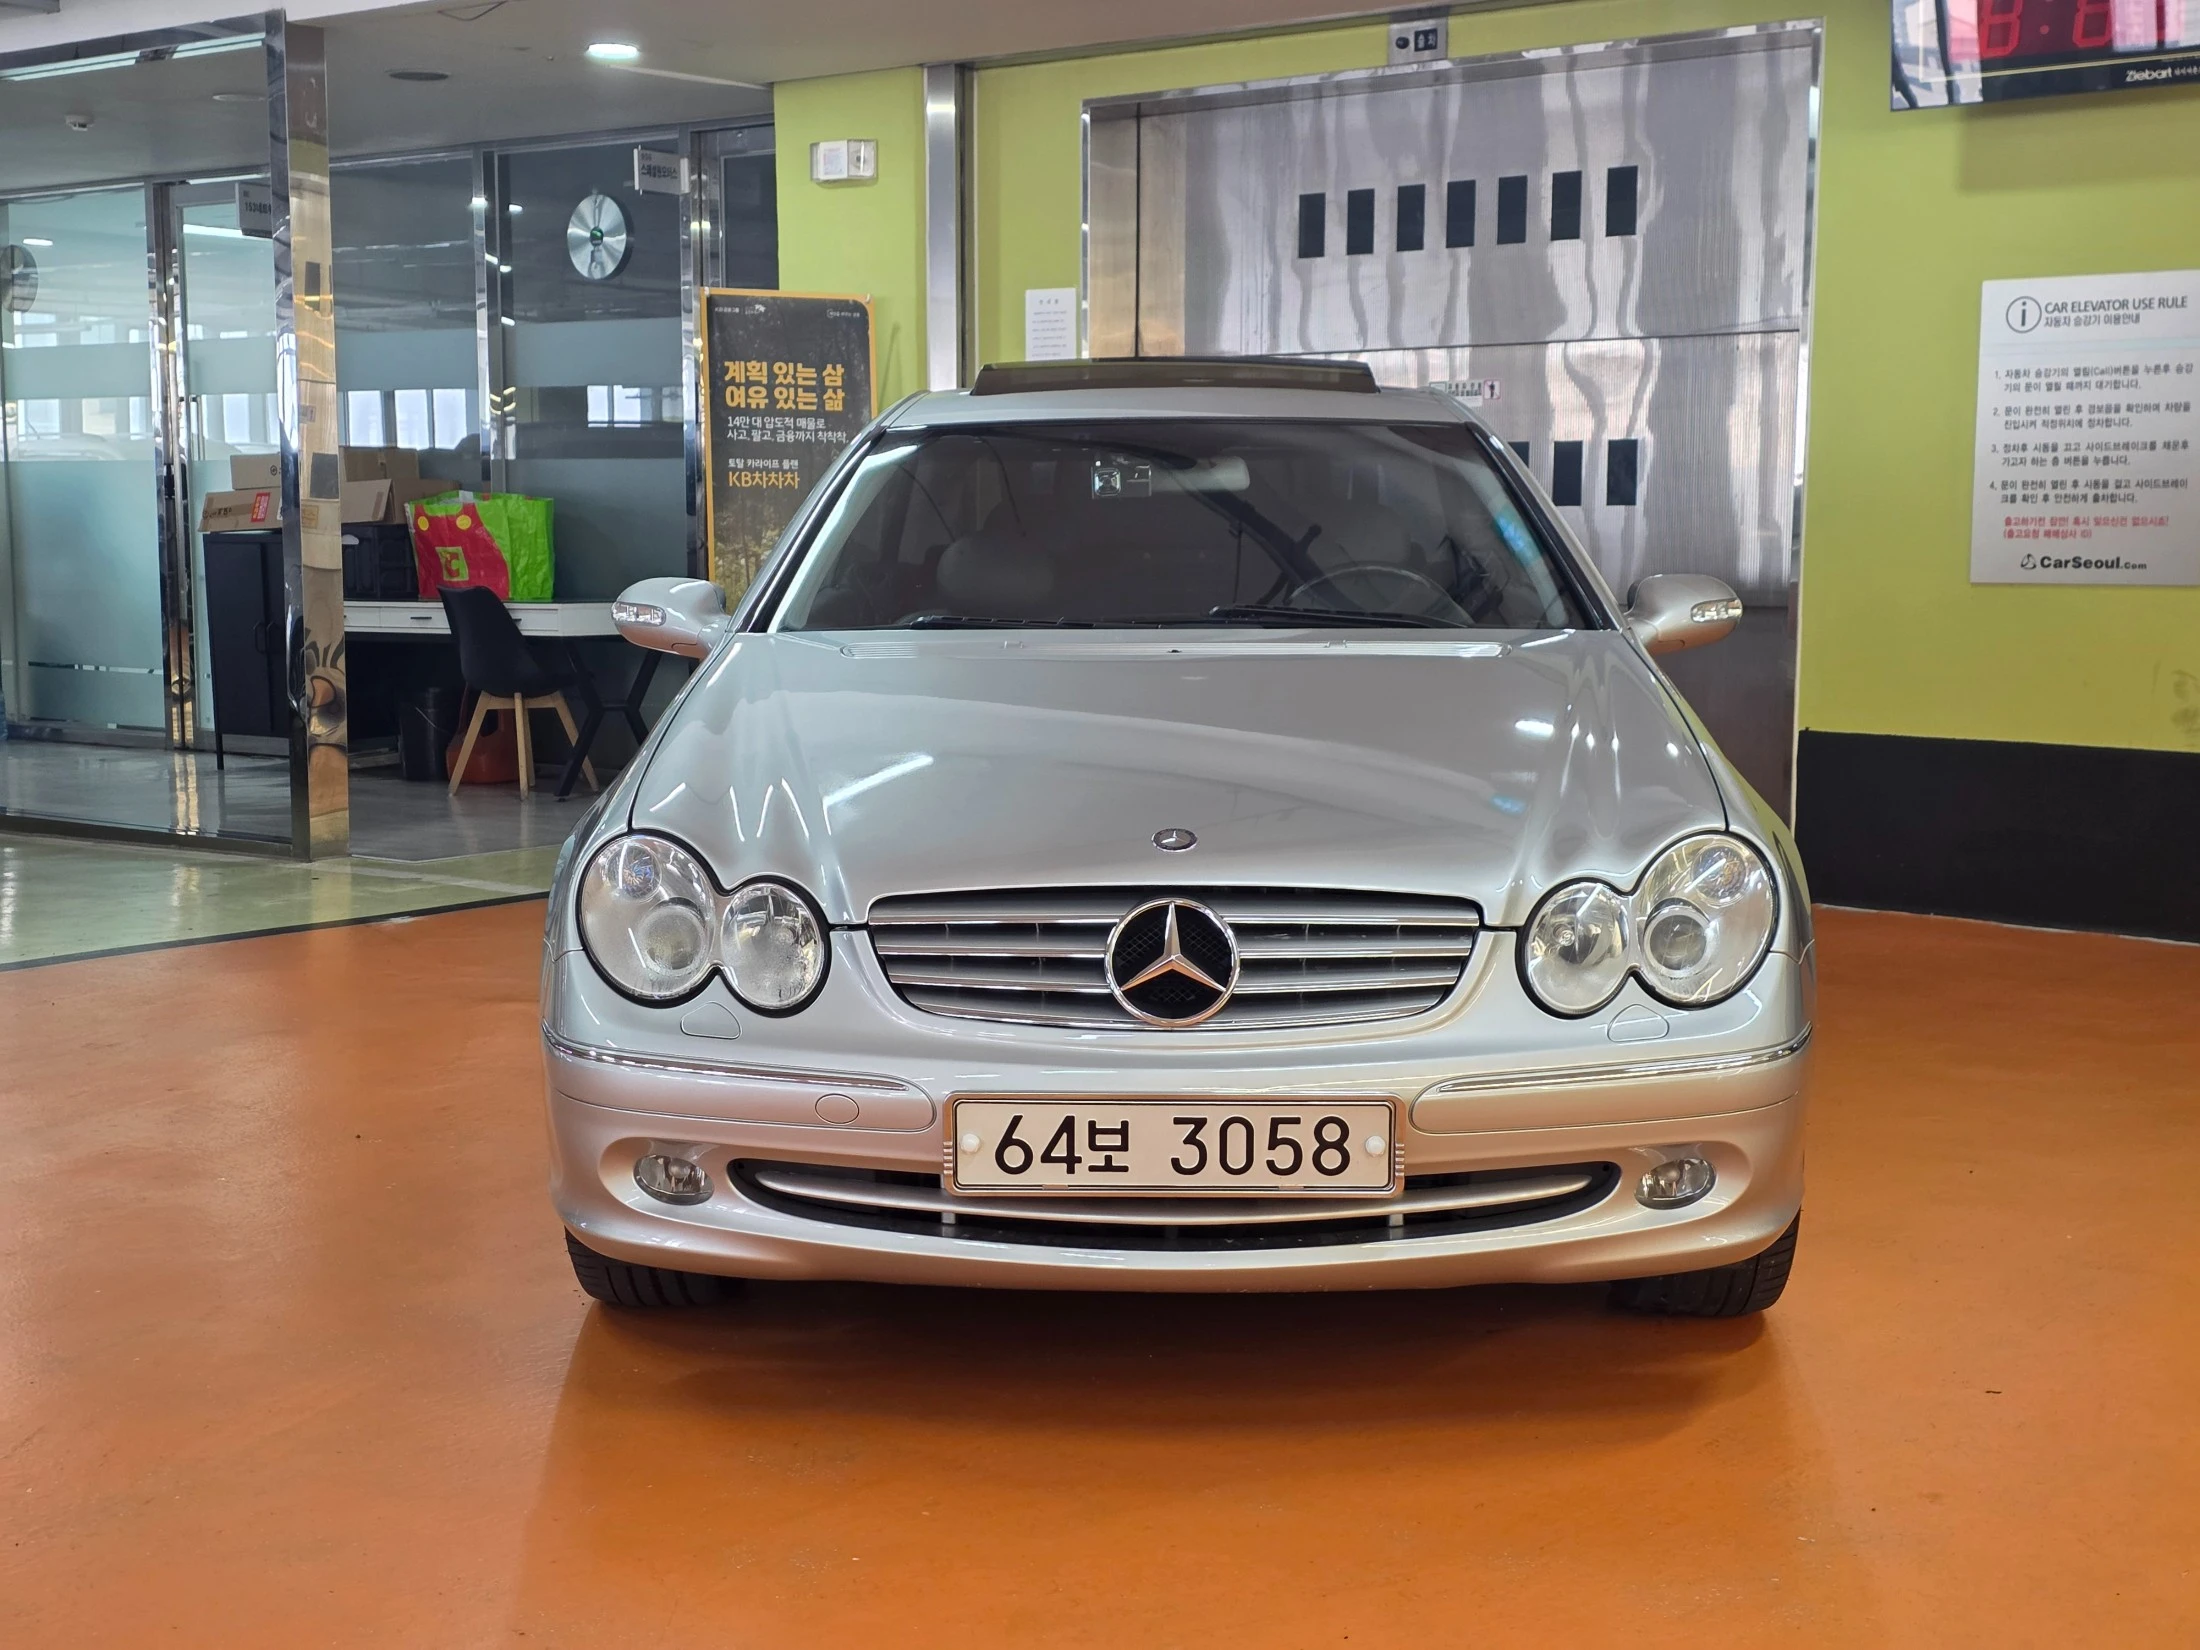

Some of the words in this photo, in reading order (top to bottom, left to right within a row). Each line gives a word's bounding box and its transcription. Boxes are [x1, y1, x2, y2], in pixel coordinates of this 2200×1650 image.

[2044, 302, 2068, 314] CAR
[2071, 299, 2129, 313] ELEVATOR
[2132, 297, 2155, 310] USE
[2158, 295, 2188, 309] RULE
[724, 360, 768, 385] 계획
[772, 361, 817, 386] 있는
[822, 363, 845, 387] 삼
[725, 385, 769, 409] 여유
[773, 386, 818, 410] 있는
[823, 388, 846, 412] 삶
[728, 416, 750, 429] 14만
[751, 416, 762, 429] 대
[763, 416, 794, 430] 압도적
[796, 417, 826, 430] 매물로
[776, 430, 815, 443] 금융까지
[728, 471, 800, 489] KB차차차
[994, 1113, 1130, 1176] 64보
[1170, 1114, 1352, 1177] 3058
